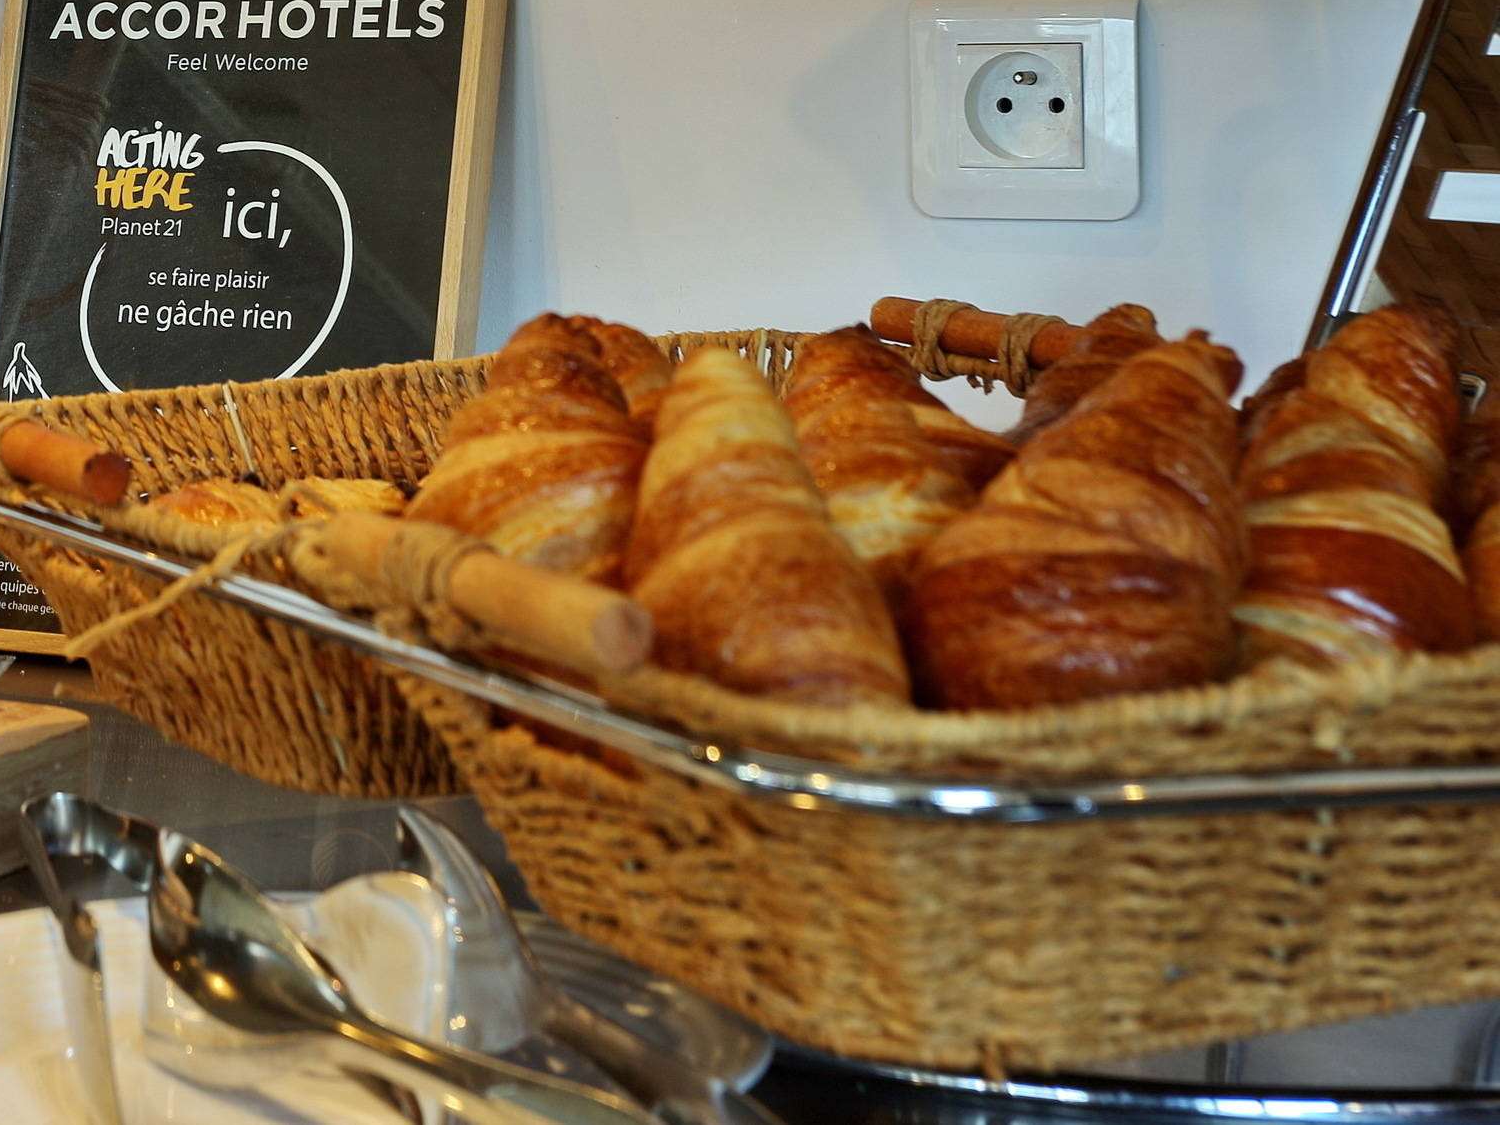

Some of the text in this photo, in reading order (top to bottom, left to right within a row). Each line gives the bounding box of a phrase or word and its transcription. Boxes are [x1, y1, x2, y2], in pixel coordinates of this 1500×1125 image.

[167, 53, 308, 71] Feel Welcome
[94, 168, 196, 211] HERE
[223, 188, 291, 248] ici,
[148, 267, 269, 292] se faire plaisir
[118, 300, 292, 331] ne gâche rien
[8, 601, 39, 613] chaque
